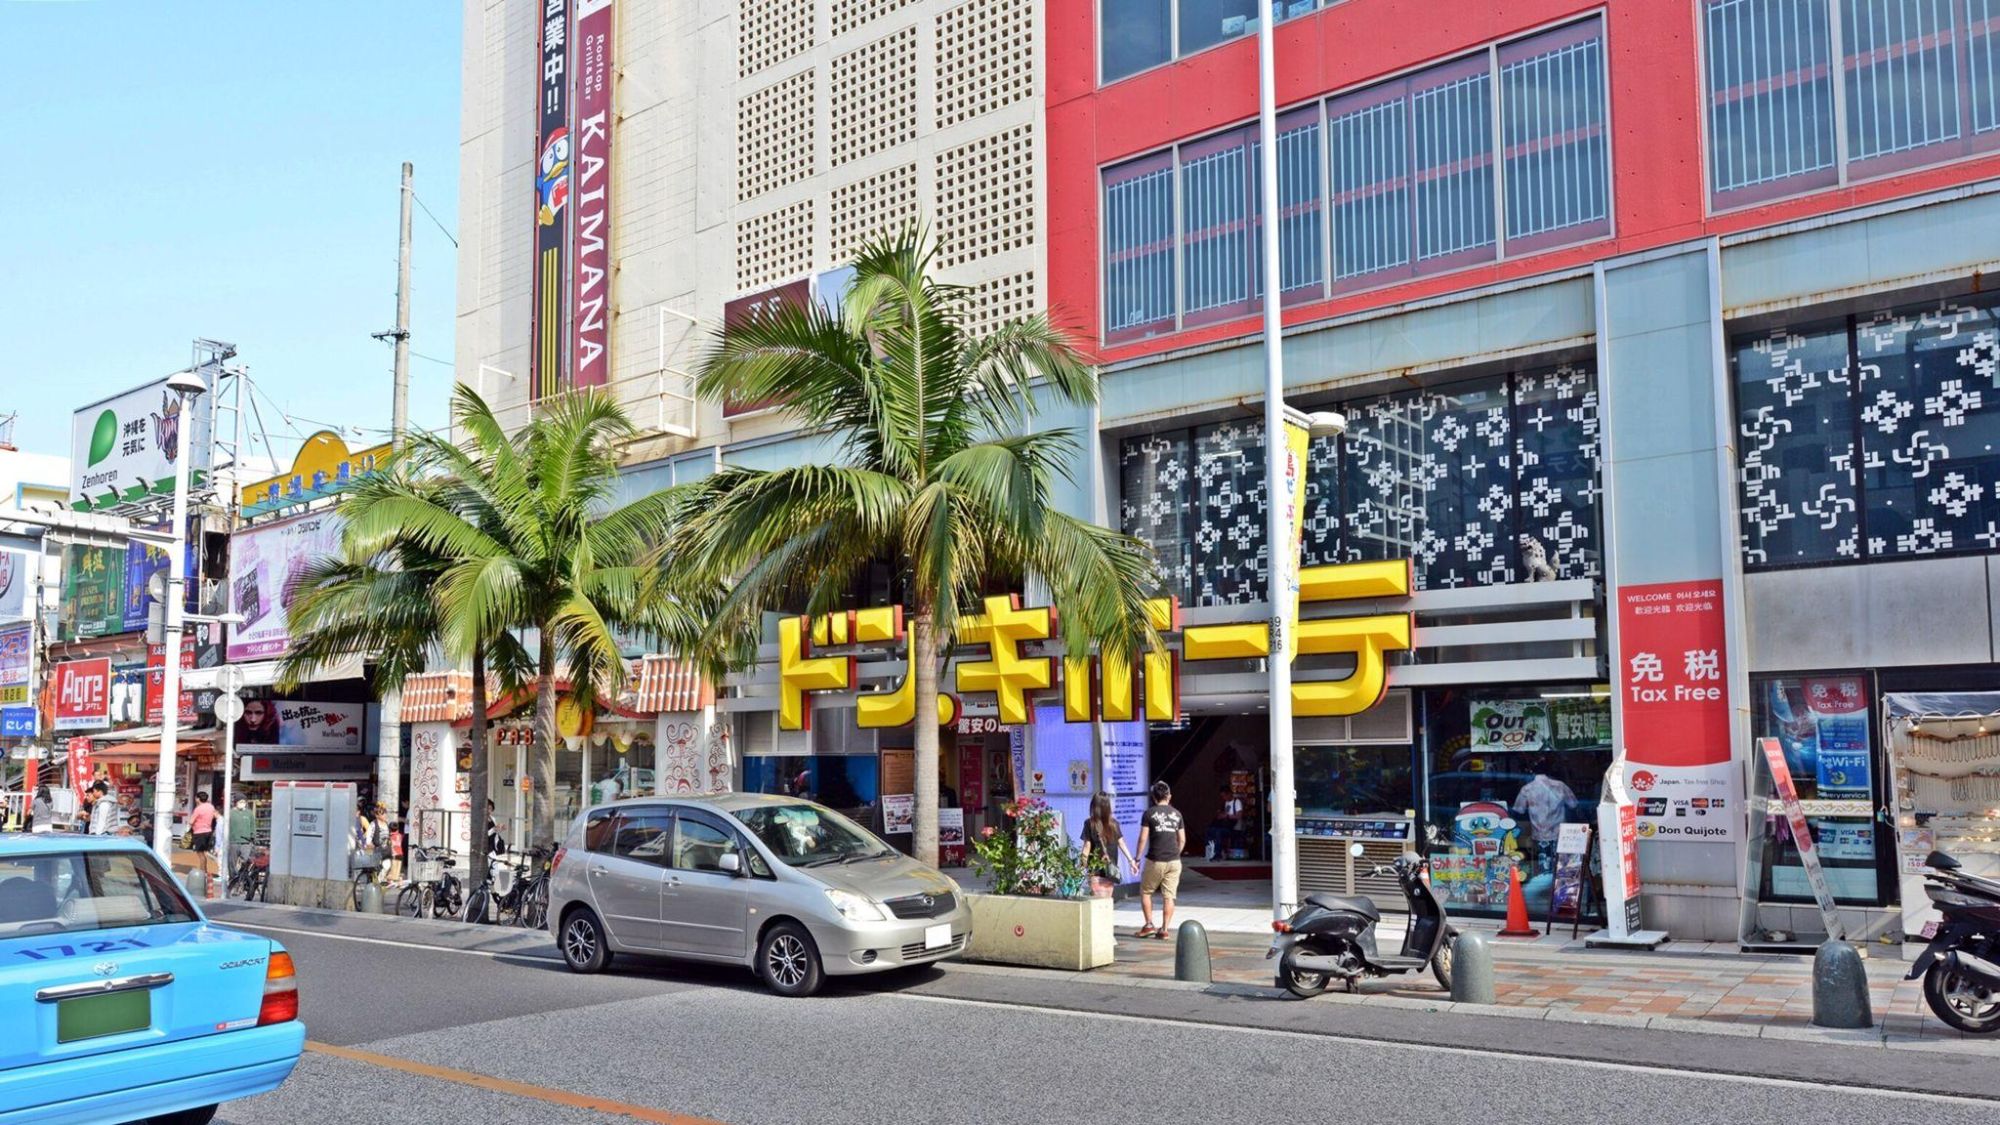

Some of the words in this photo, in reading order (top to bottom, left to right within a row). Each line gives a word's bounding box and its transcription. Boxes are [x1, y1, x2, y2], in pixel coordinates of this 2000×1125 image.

[594, 33, 605, 92] Rooftop
[579, 109, 606, 372] KAIMANA
[122, 418, 146, 438] 沖縄を
[122, 438, 146, 457] 元気に
[81, 469, 119, 490] Zenhoren
[1627, 592, 1673, 603] WELCOME
[61, 669, 103, 713] Agre
[1631, 686, 1669, 702] Tax
[1674, 684, 1721, 701] Free
[1811, 682, 1858, 698] 免税
[1817, 701, 1832, 709] Tax
[1834, 701, 1855, 709] Free
[1486, 713, 1525, 729] OUT
[1489, 730, 1537, 745] DOOR
[1831, 756, 1866, 768] Wi-Fi
[1658, 825, 1681, 834] Don
[1684, 826, 1728, 838] Quijote
[14, 937, 151, 960] 1721
